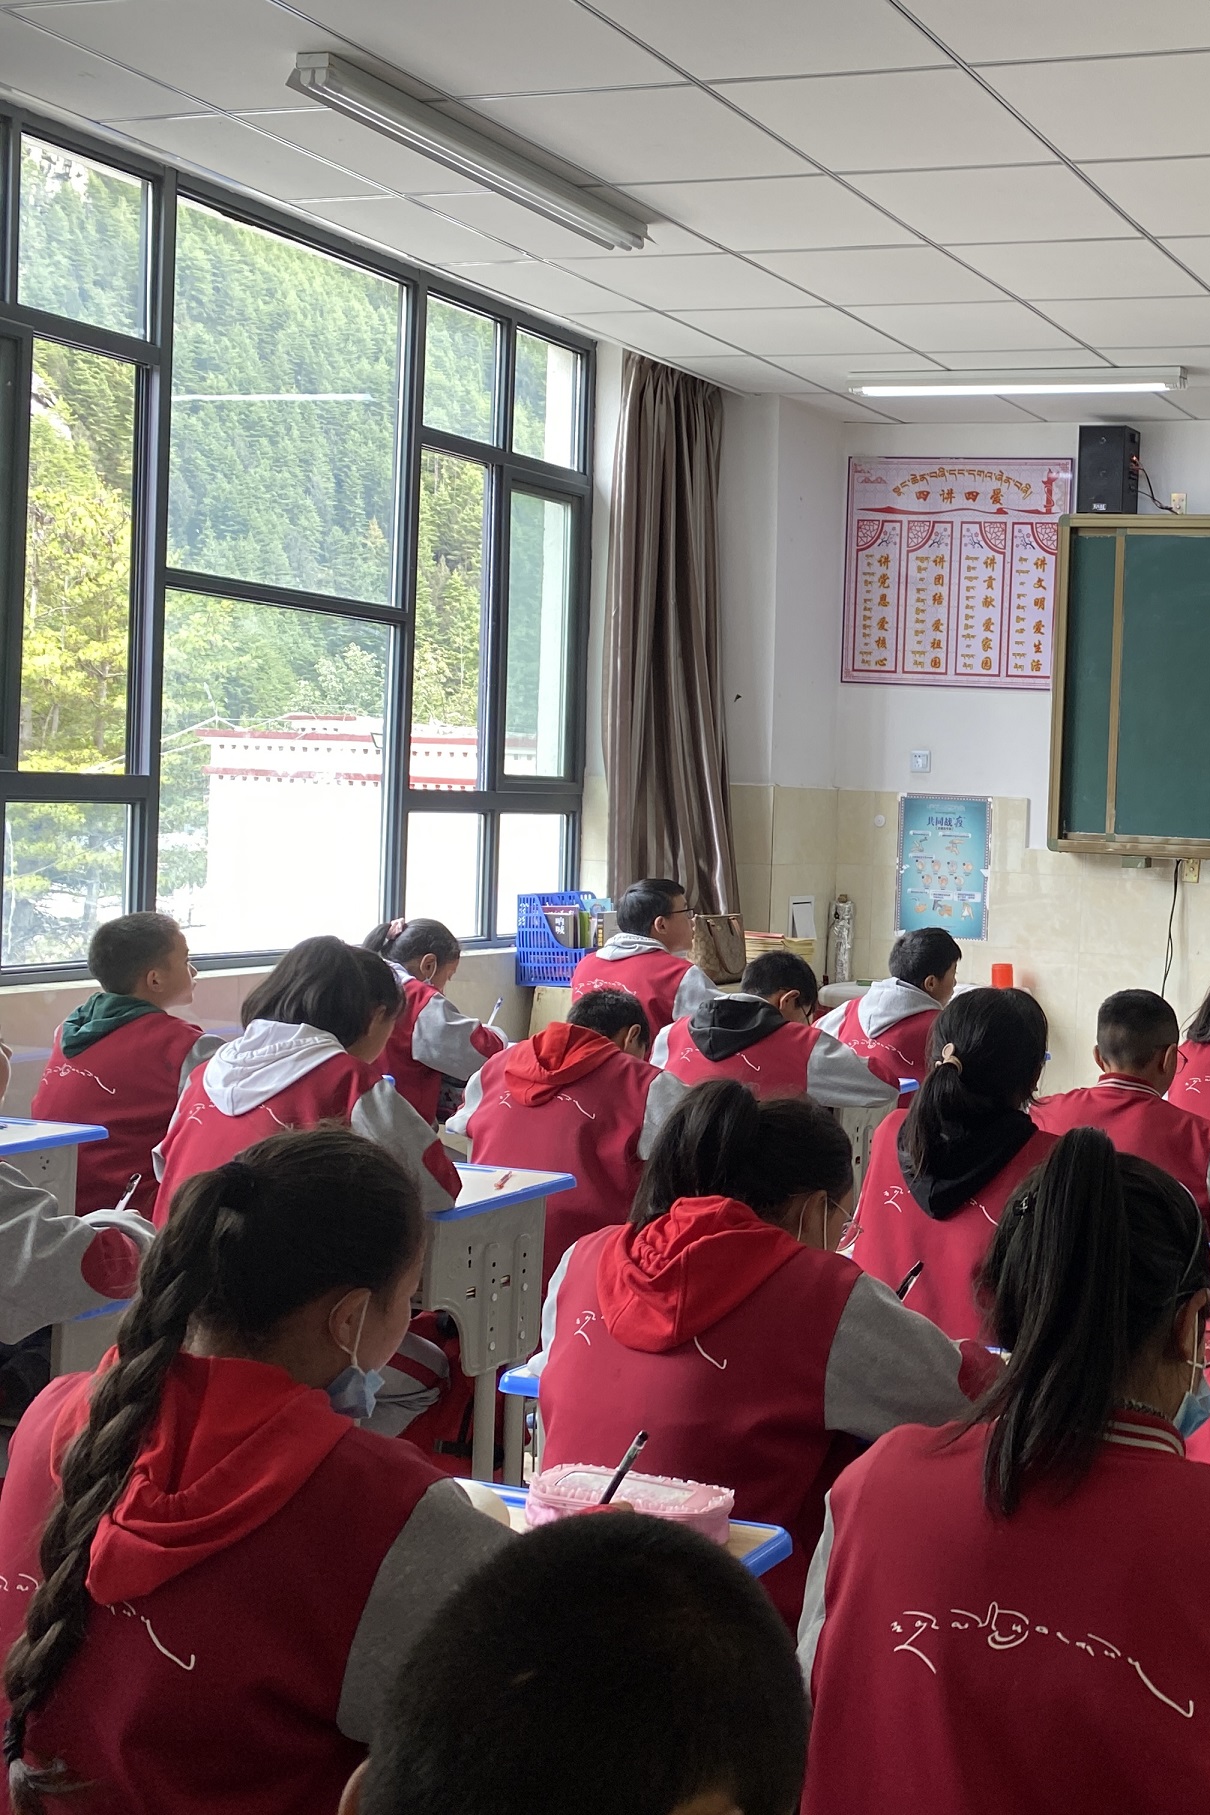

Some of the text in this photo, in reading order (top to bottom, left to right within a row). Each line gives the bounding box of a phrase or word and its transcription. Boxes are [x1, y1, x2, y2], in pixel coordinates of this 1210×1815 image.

[914, 488, 1005, 506] 四讲四爱
[875, 553, 891, 667] 讲党恩 爱核心
[930, 553, 947, 669] 讲团结 爱祖国
[980, 555, 997, 671] 讲贡献 爱家园
[1030, 556, 1048, 673] 讲文明 爱生活
